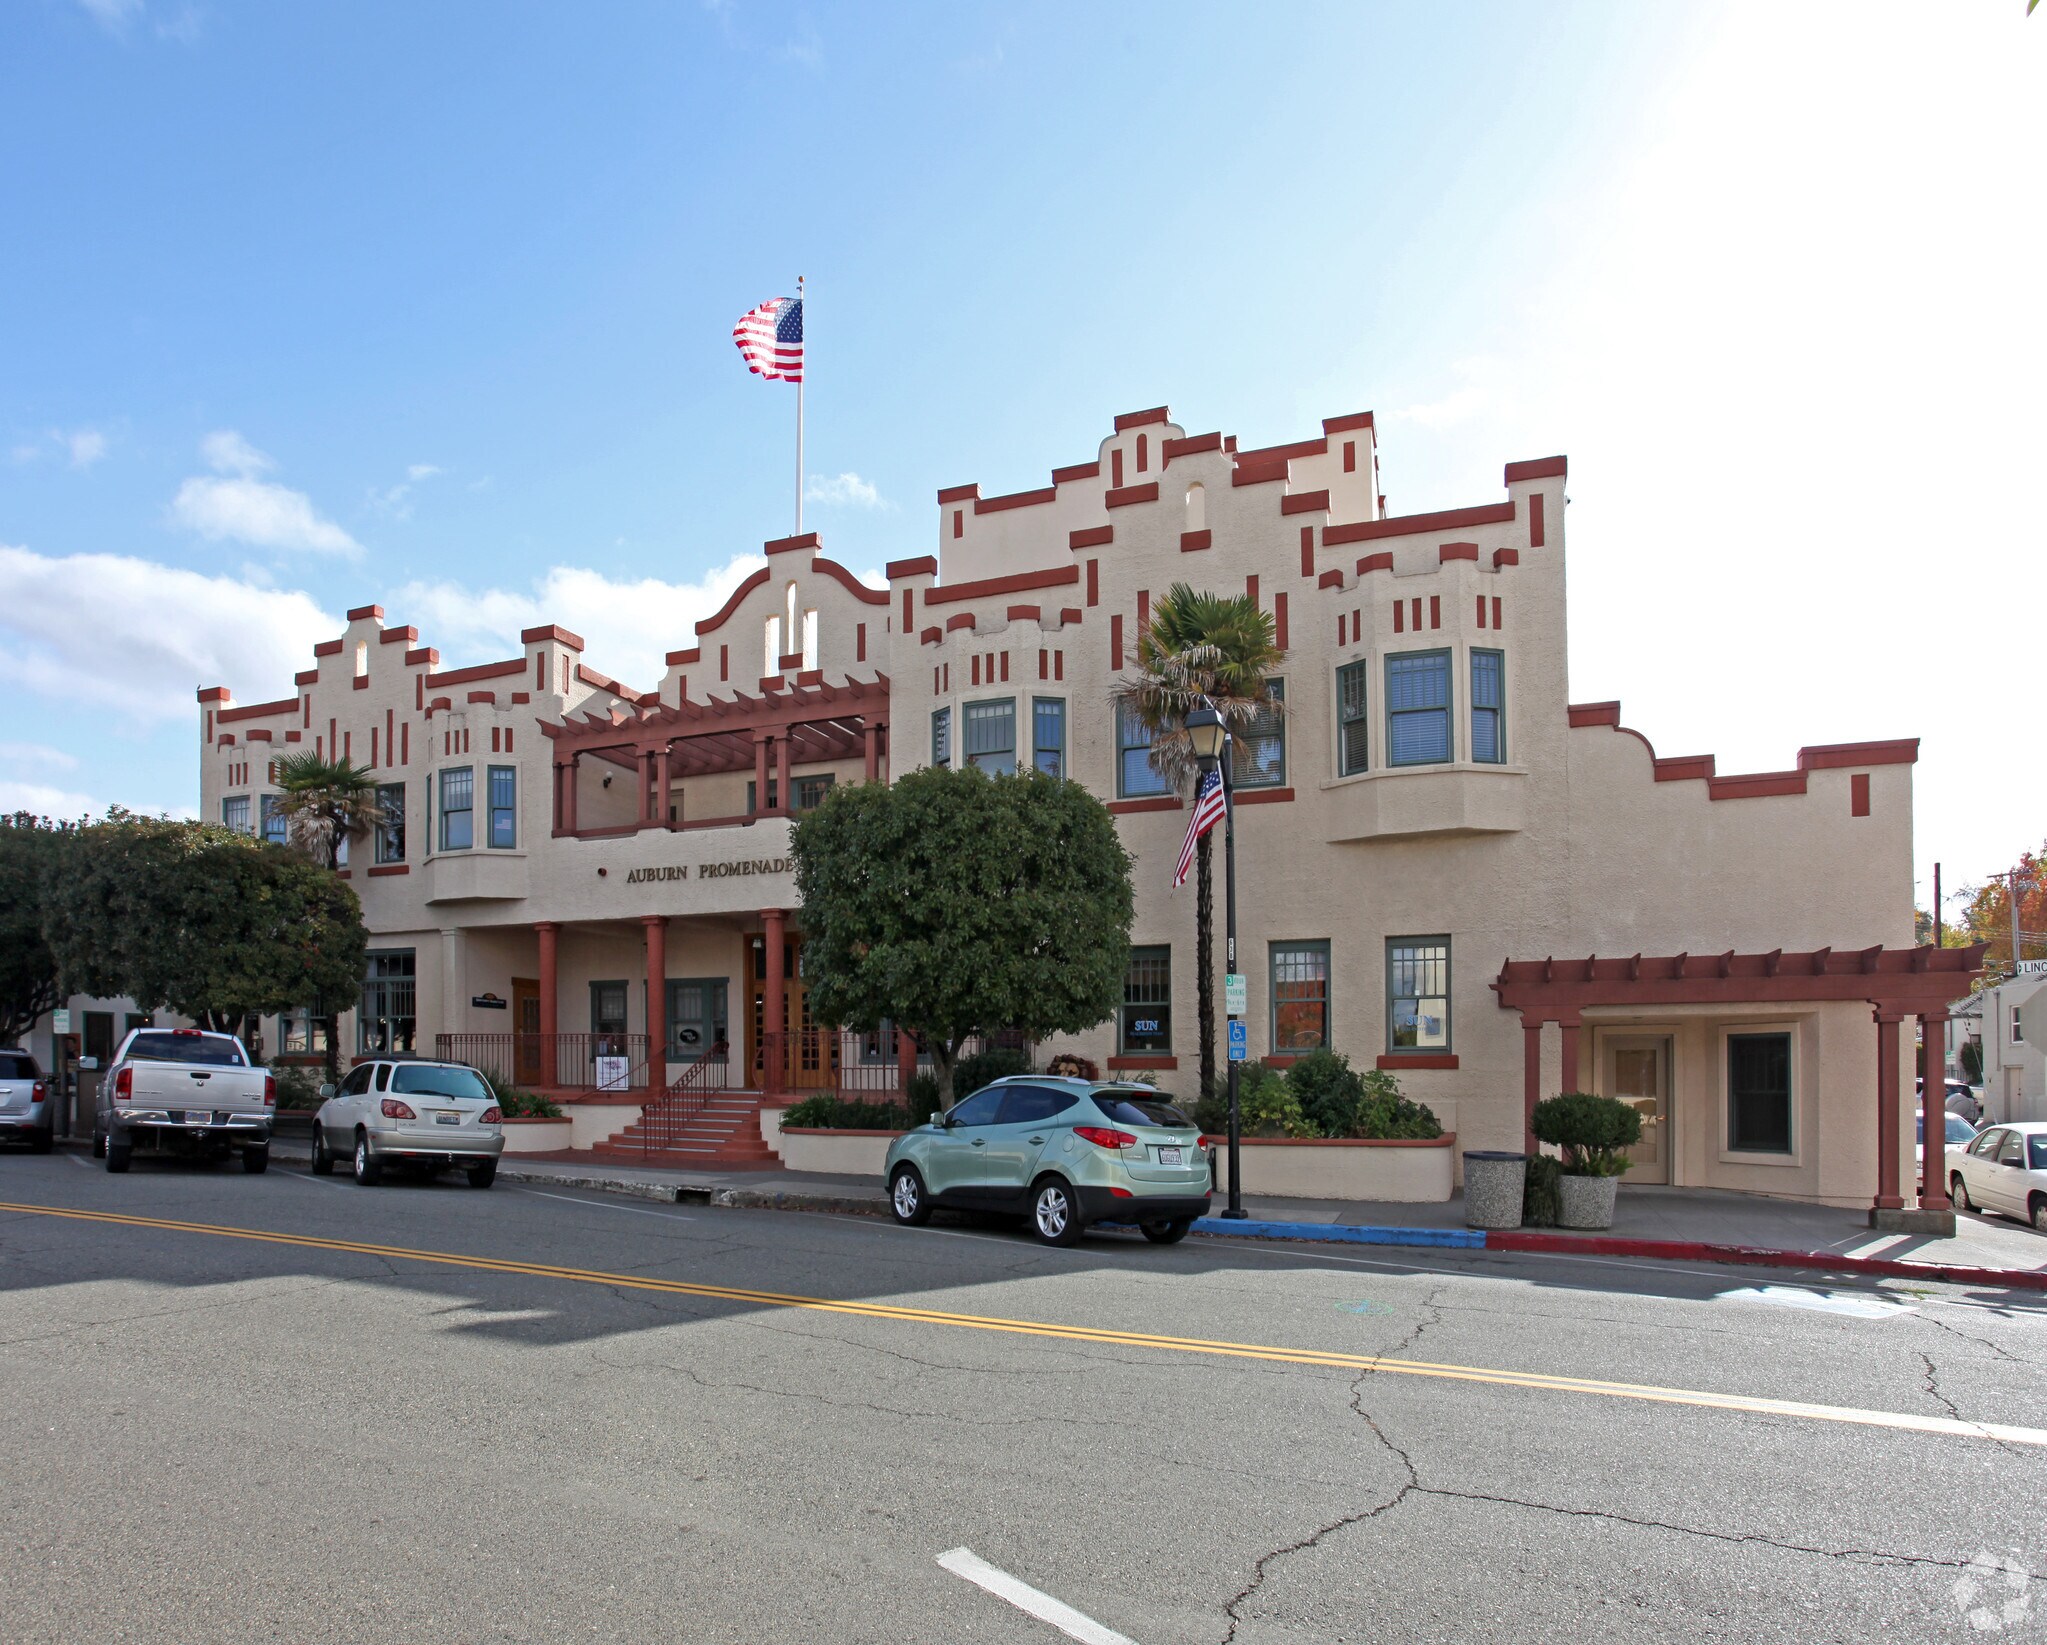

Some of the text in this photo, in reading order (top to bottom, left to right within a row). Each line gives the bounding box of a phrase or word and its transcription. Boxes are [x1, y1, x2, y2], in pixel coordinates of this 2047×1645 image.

[627, 858, 795, 883] AUBURN PROMENADE
[2024, 962, 2047, 973] LINC
[1227, 976, 1232, 985] 3
[1227, 988, 1245, 996] PARKING
[1134, 1020, 1159, 1031] SUN
[1406, 1015, 1433, 1026] SUN
